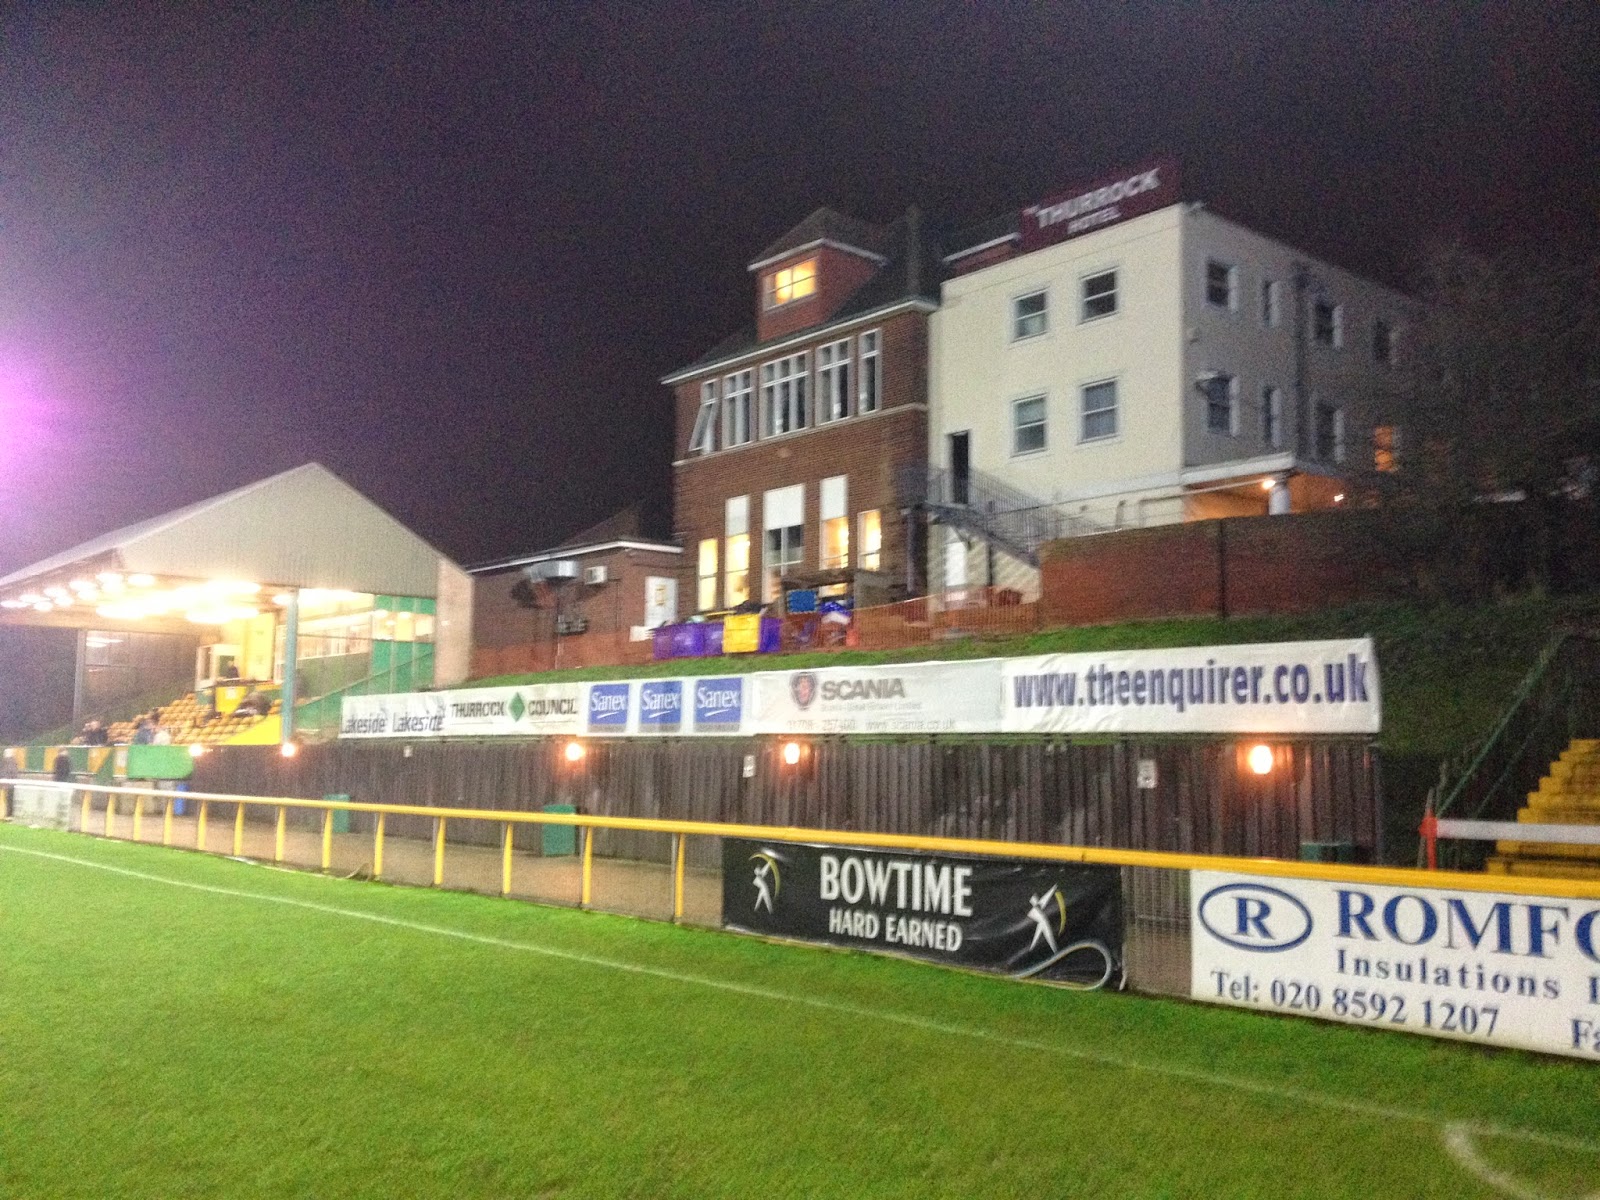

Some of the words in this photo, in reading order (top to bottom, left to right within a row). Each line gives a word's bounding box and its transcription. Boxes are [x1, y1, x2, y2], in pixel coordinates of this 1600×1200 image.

[1035, 167, 1162, 229] THURROCK
[1067, 205, 1121, 234] HOTEL
[642, 690, 680, 710] Sanex
[697, 686, 739, 709] Sanex
[821, 678, 906, 700] SCANIA
[1013, 653, 1368, 712] www.theenquirer.co.uk
[451, 701, 505, 717] THURROCK
[528, 698, 578, 715] COUNCIL
[591, 691, 625, 711] Sanex
[392, 711, 444, 733] Lakeside
[819, 855, 974, 917] BOWTIME
[828, 908, 880, 938] HARD
[885, 913, 963, 952] EARNED
[1230, 896, 1276, 940] R
[1337, 948, 1561, 999] Insulations
[1210, 970, 1260, 1003] Tel:
[1270, 979, 1321, 1012] 020
[1332, 987, 1407, 1025] 8592
[1423, 999, 1499, 1038] 1207
